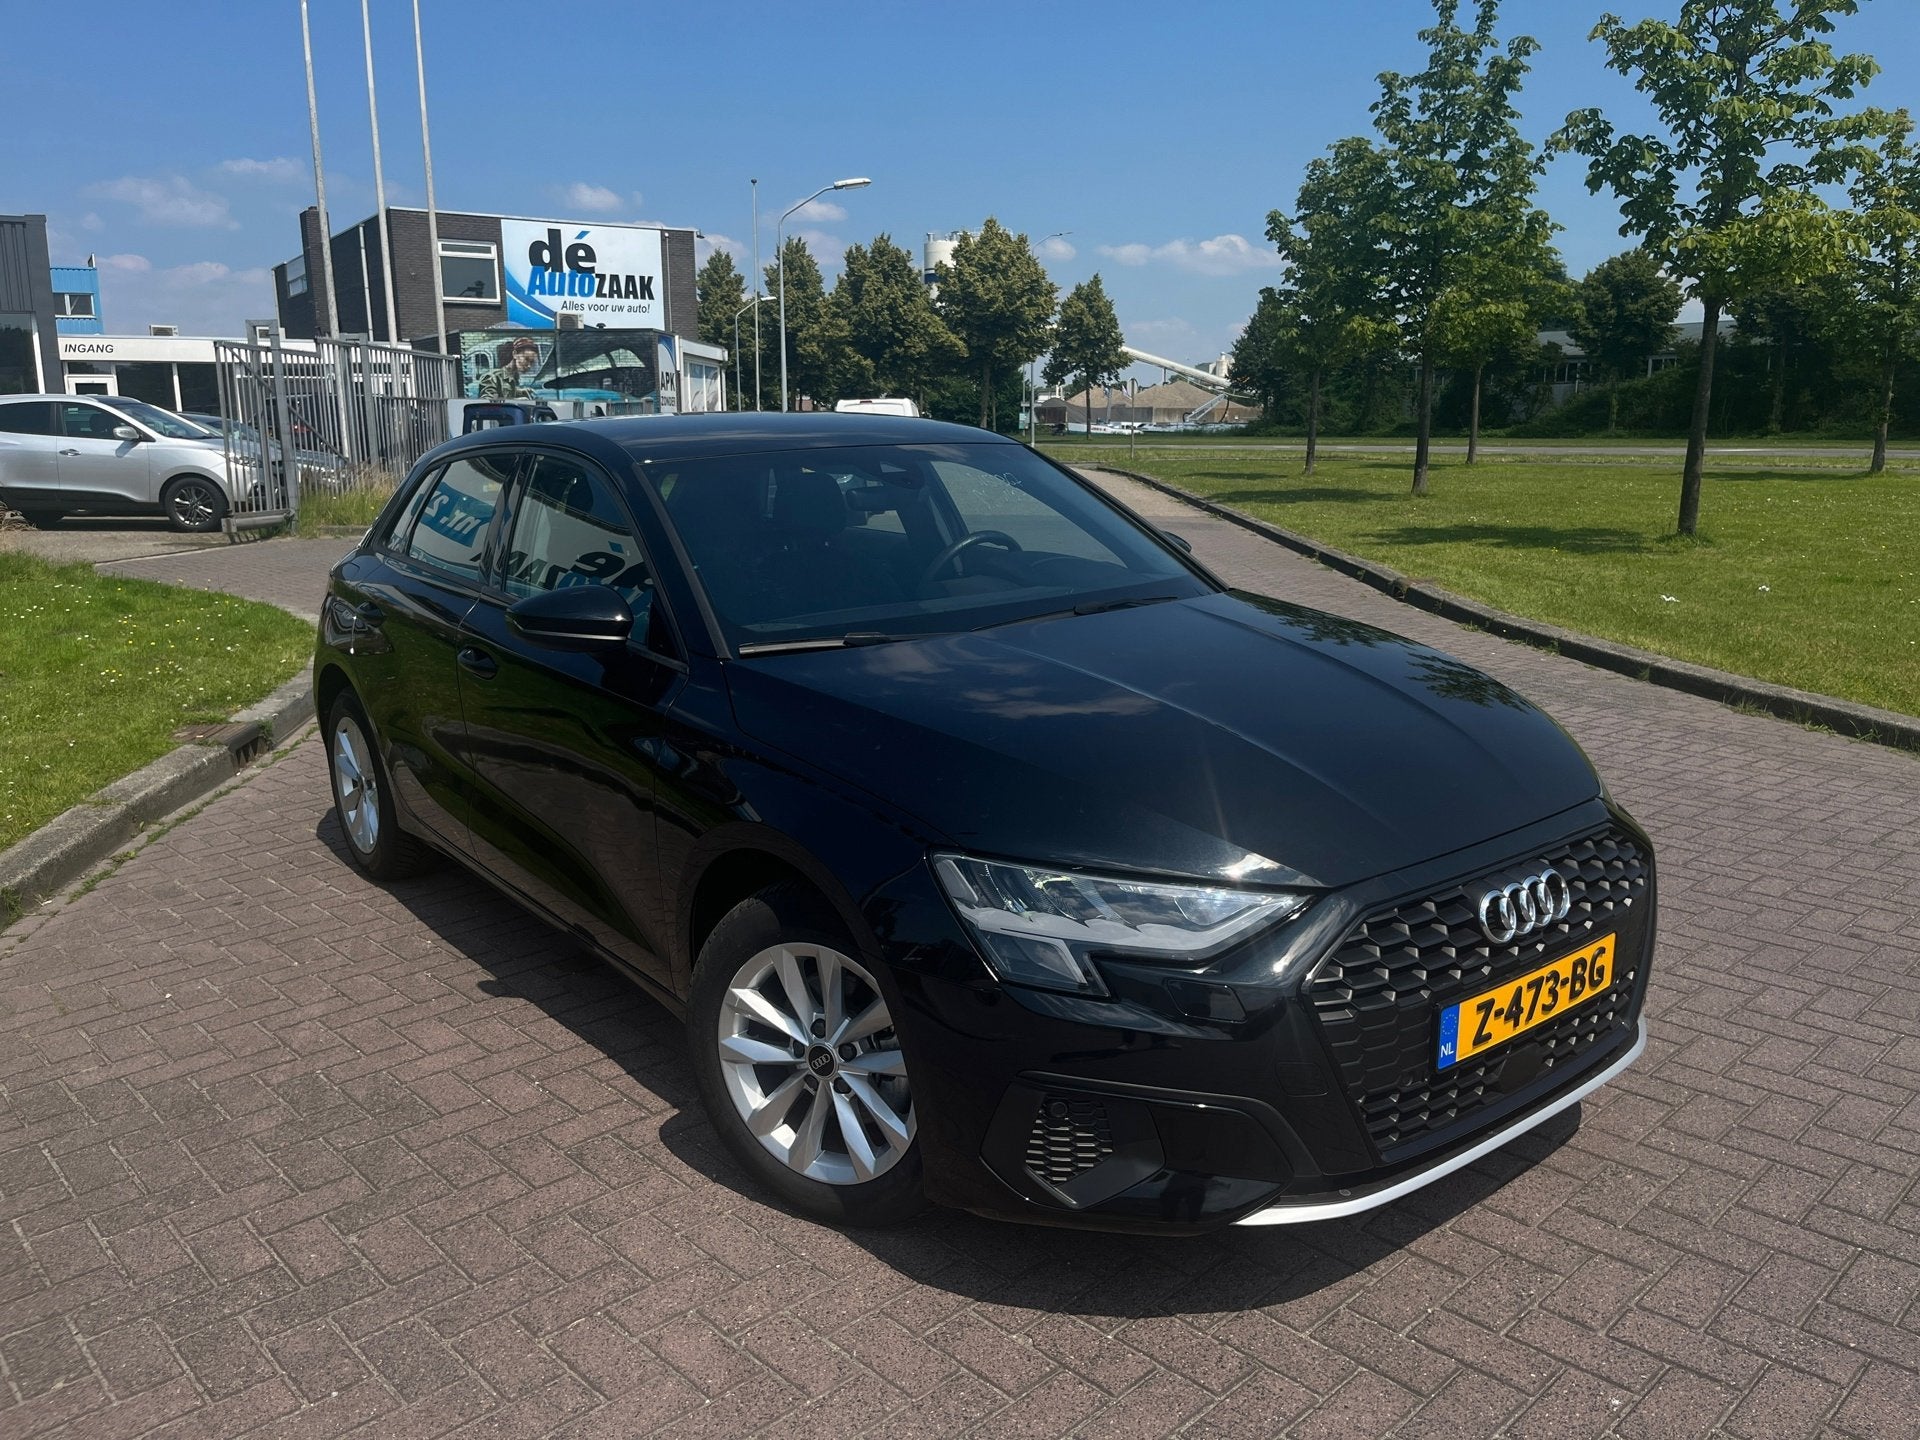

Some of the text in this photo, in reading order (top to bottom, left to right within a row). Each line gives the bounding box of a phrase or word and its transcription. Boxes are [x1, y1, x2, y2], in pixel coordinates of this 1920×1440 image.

[529, 228, 597, 274] dé
[561, 300, 651, 314] Alles voor uw auto!
[64, 343, 114, 353] INGANG
[660, 371, 676, 391] APK
[1472, 946, 1607, 1047] Z-473-BG
[1440, 1041, 1455, 1058] NL
